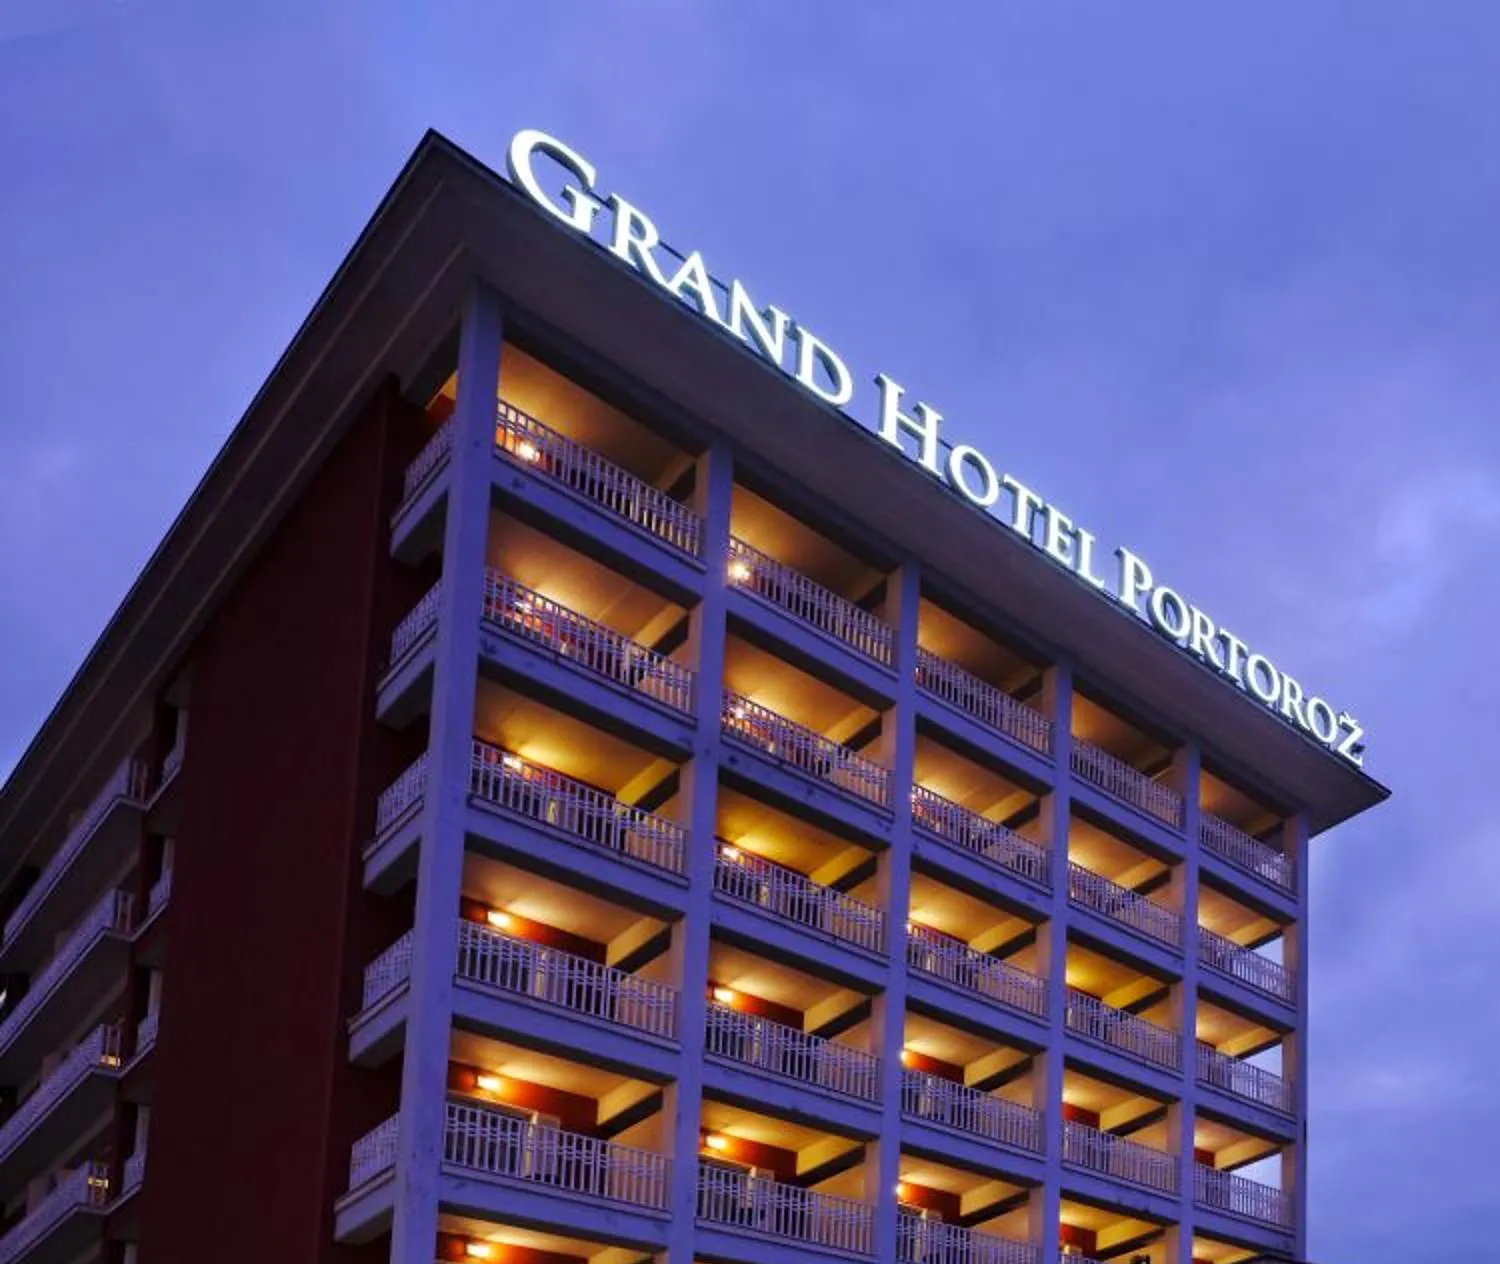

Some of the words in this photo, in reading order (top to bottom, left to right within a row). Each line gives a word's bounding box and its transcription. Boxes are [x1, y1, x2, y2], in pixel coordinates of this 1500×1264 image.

[509, 129, 853, 406] GRAND
[876, 373, 1104, 587] HOTEL
[1116, 546, 1364, 767] PORTOROŽ
